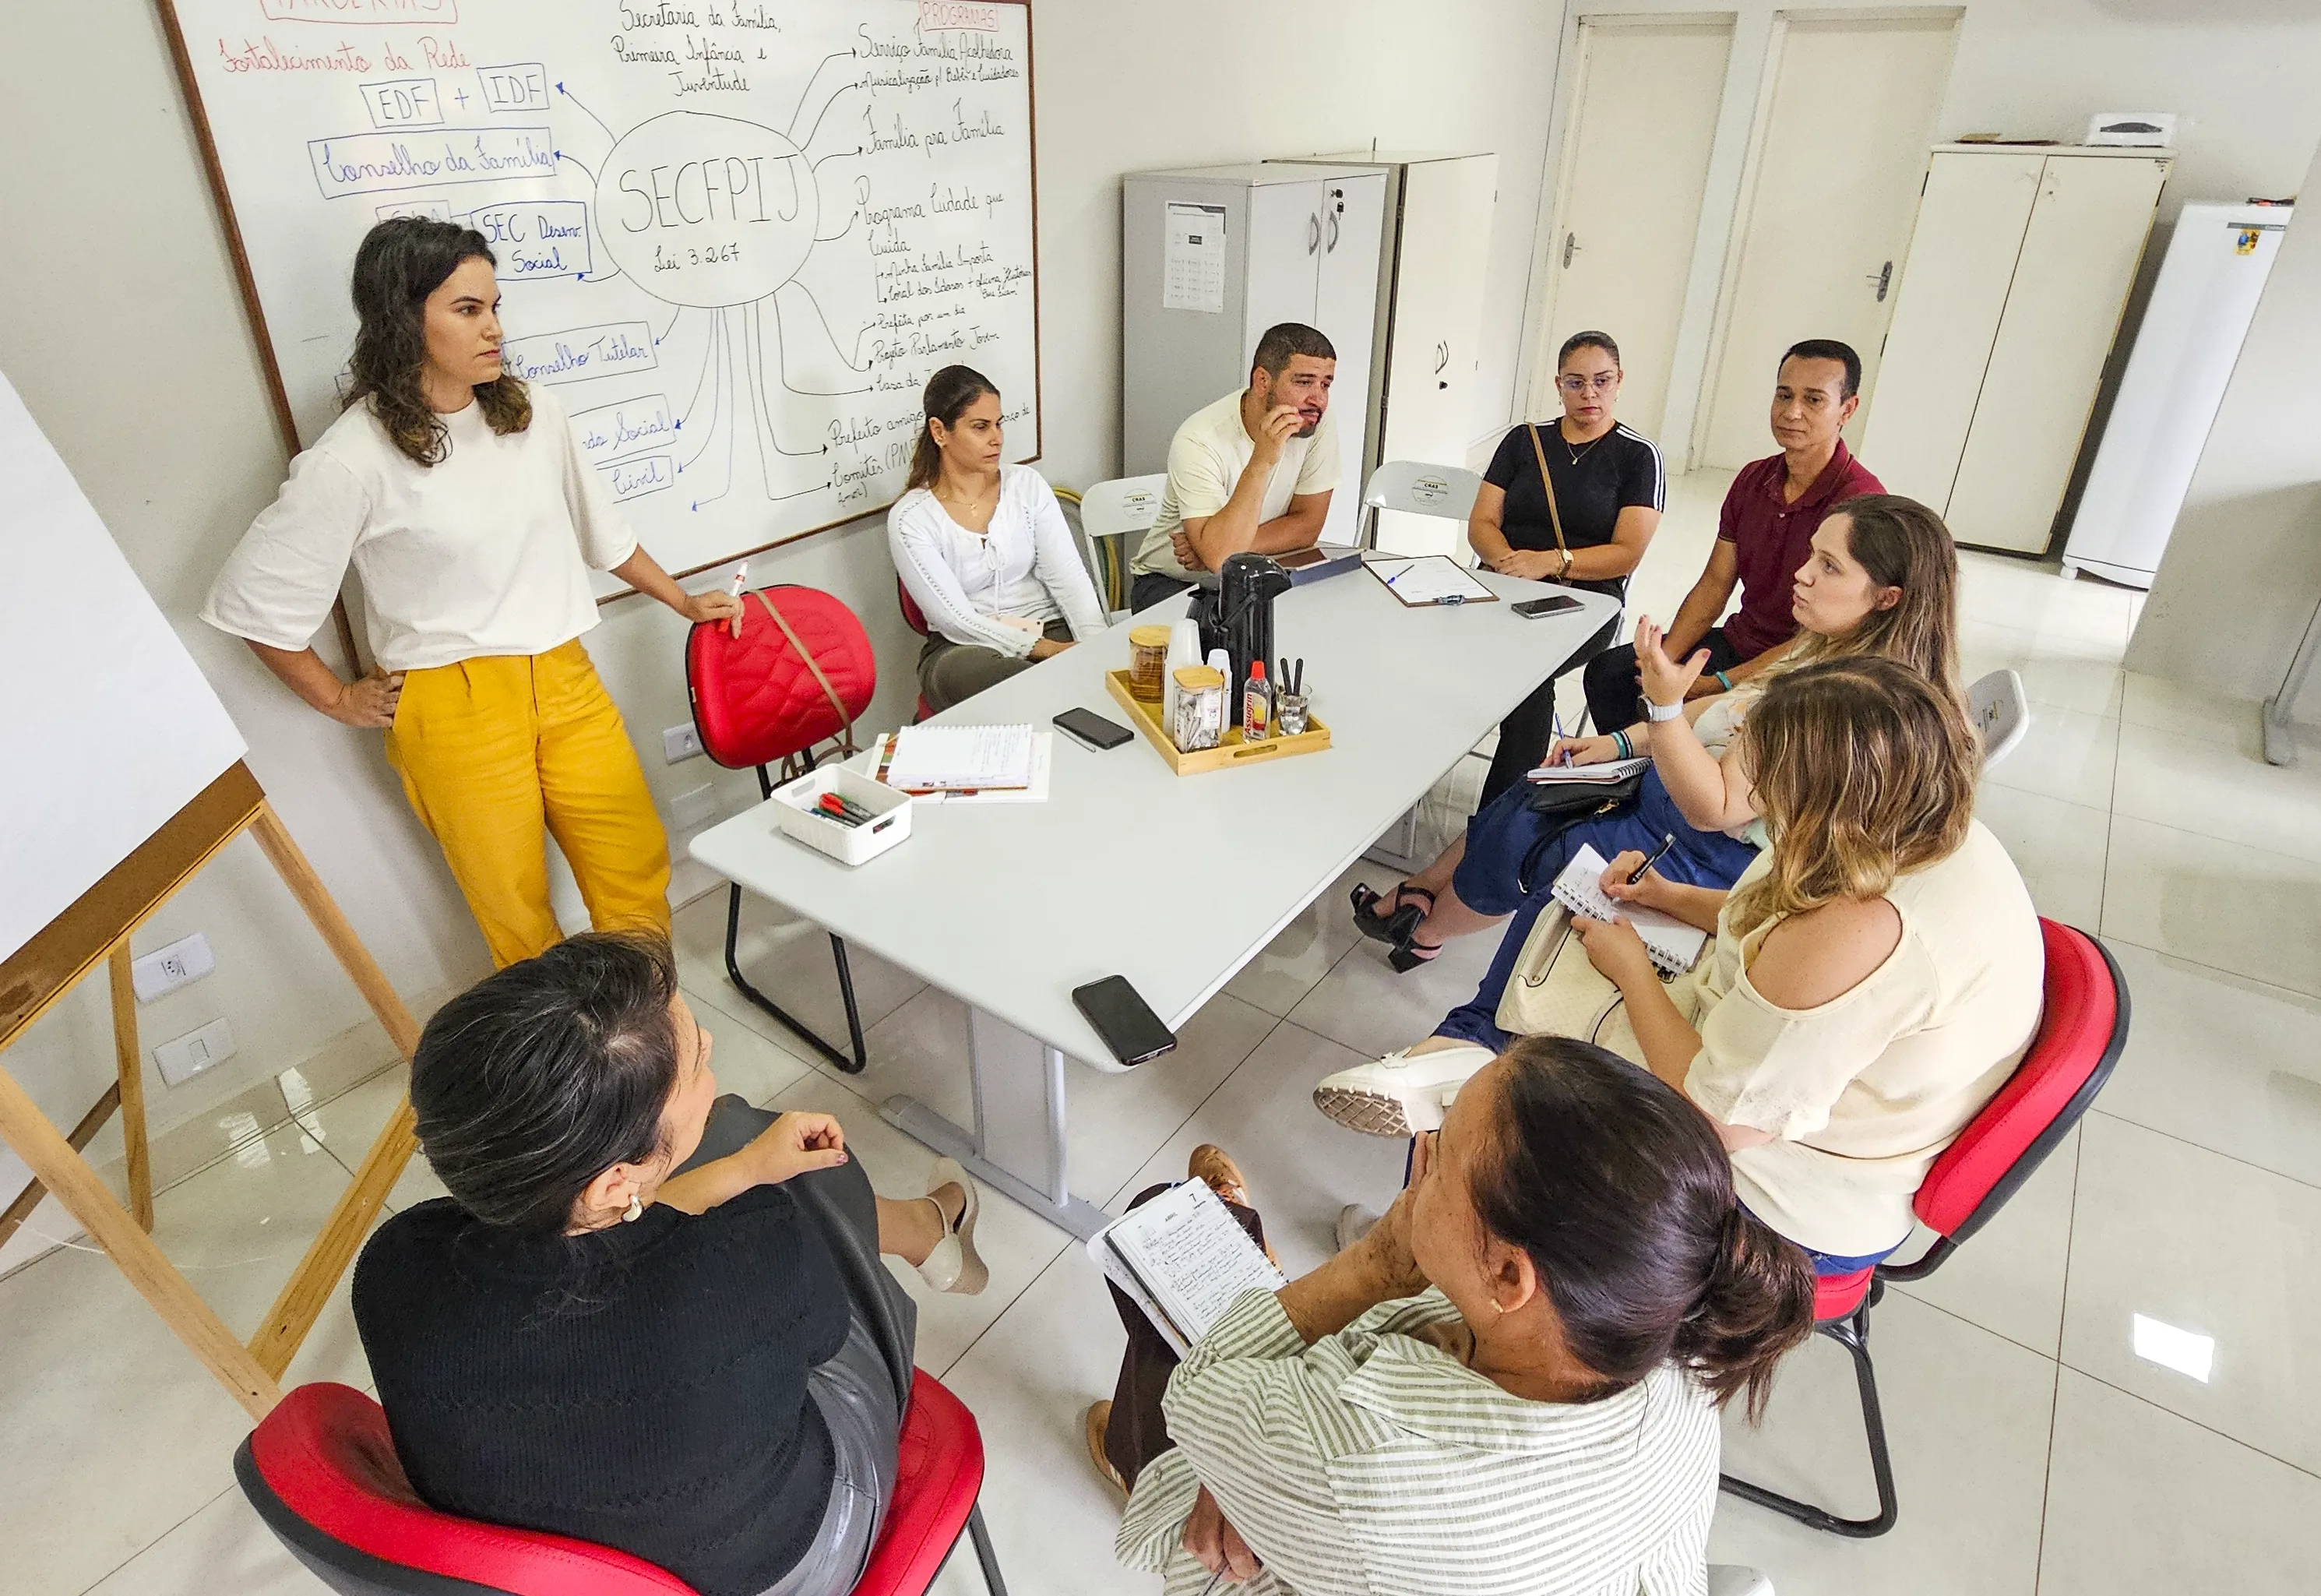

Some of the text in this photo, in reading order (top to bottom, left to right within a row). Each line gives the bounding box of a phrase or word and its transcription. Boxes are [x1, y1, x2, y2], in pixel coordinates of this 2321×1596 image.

[619, 0, 699, 30] Secretaria
[708, 4, 725, 28] da
[922, 2, 995, 28] PROGRAMAS
[384, 41, 414, 71] da
[417, 36, 470, 70] Rede
[611, 35, 681, 65] Primeira
[757, 48, 767, 60] e
[858, 23, 910, 63] Serviço
[379, 85, 431, 120] EDF
[490, 74, 542, 104] IDF
[668, 67, 751, 97] Juventude
[323, 142, 441, 183] Conselho
[446, 143, 474, 173] da
[619, 153, 798, 233] SECFPIJ
[854, 175, 926, 237] Programa
[929, 182, 979, 213] Cidade
[482, 213, 526, 243] SEC
[867, 227, 911, 256] Cuida
[512, 247, 568, 273] Social
[654, 242, 740, 272] Lei 3.267
[515, 333, 649, 380] Conselho Tutelar
[875, 373, 905, 392] Casa
[613, 410, 671, 452] Social
[827, 416, 882, 455] Prefeito
[612, 461, 665, 495] Civil
[831, 452, 885, 488] Comitês
[1245, 693, 1255, 735] Assugrin
[1189, 1193, 1197, 1202] 7
